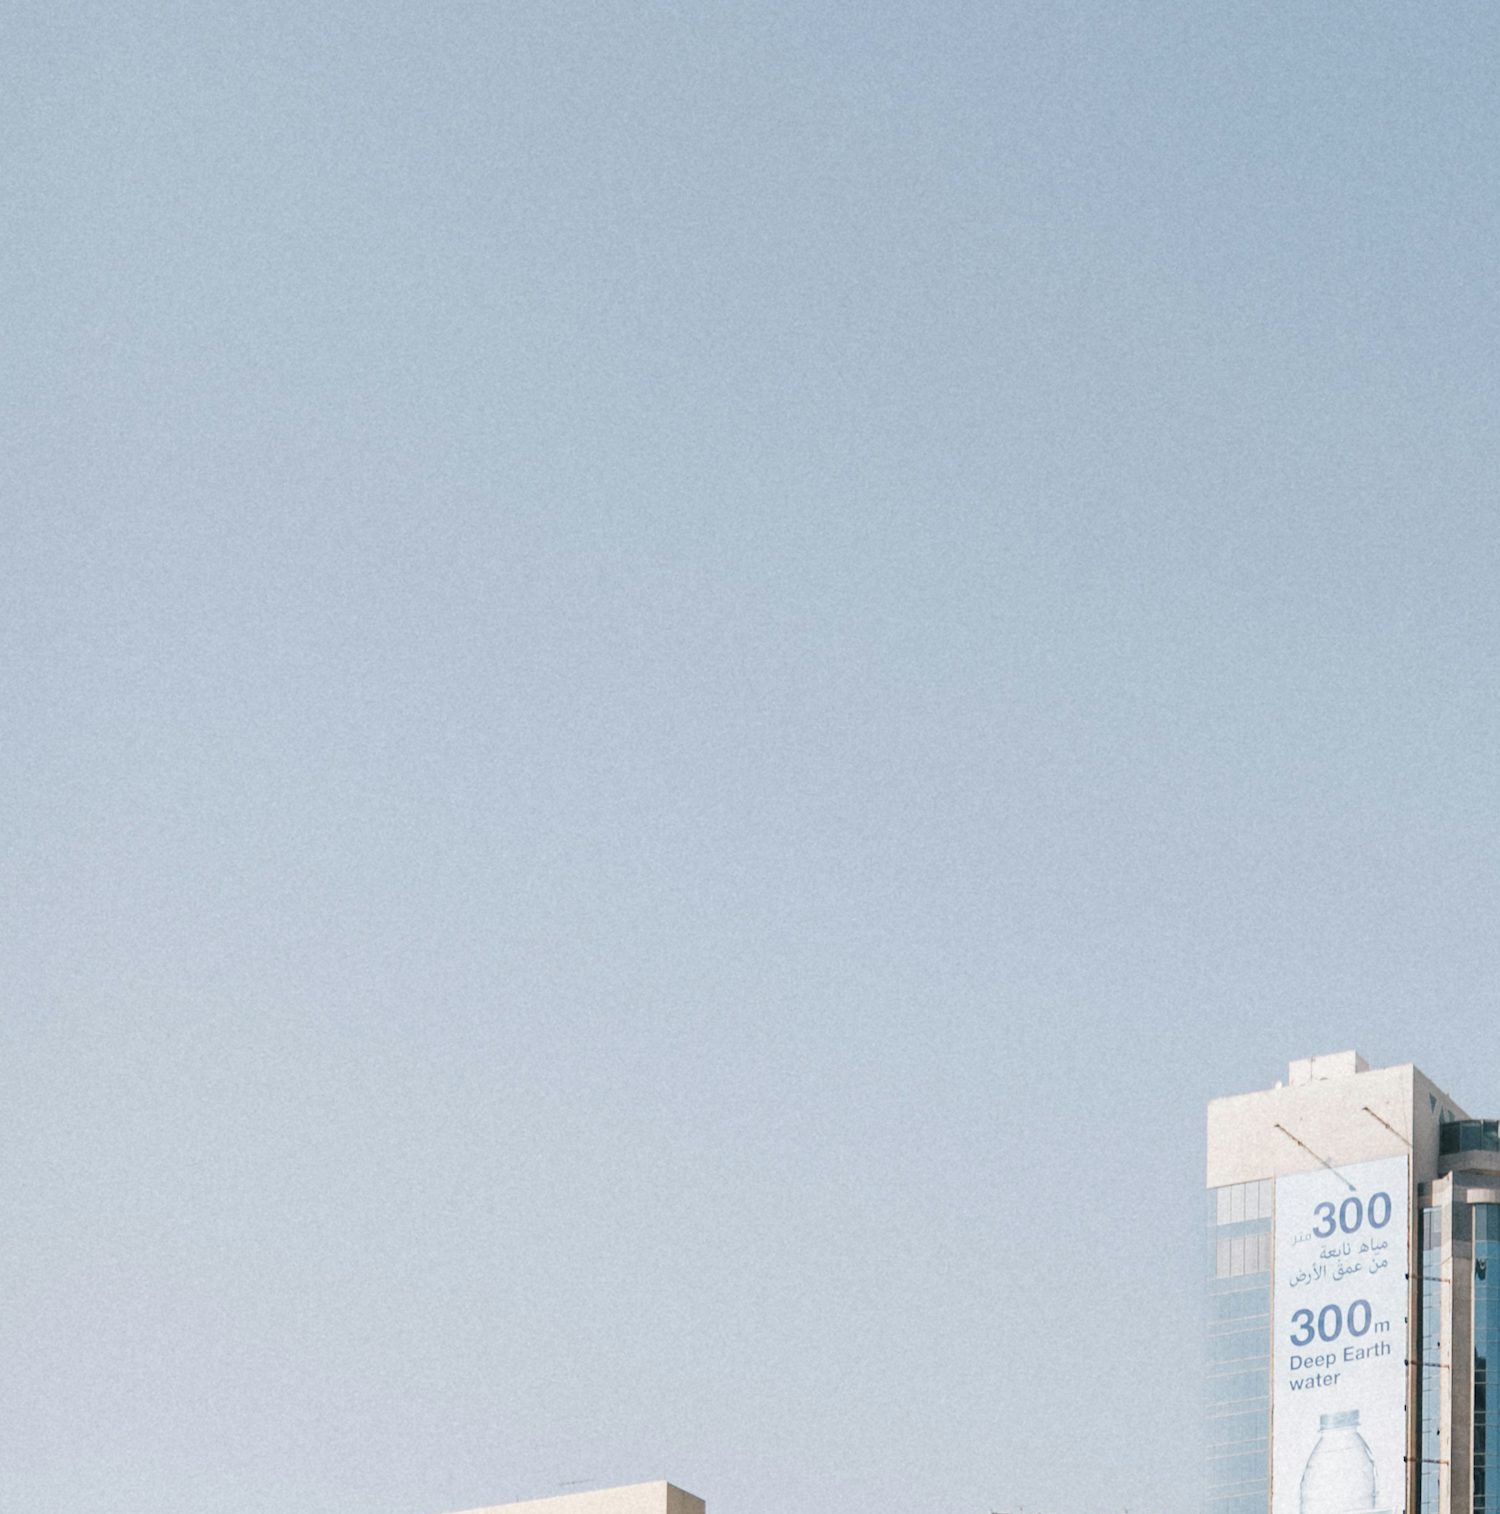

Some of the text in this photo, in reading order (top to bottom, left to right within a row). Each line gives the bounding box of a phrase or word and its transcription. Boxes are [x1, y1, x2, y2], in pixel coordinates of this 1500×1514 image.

[1312, 1191, 1392, 1239] 300
[1289, 1257, 1389, 1287] من عمق الأرض
[1290, 1341, 1391, 1371] Deep Earth
[1290, 1373, 1341, 1391] water
